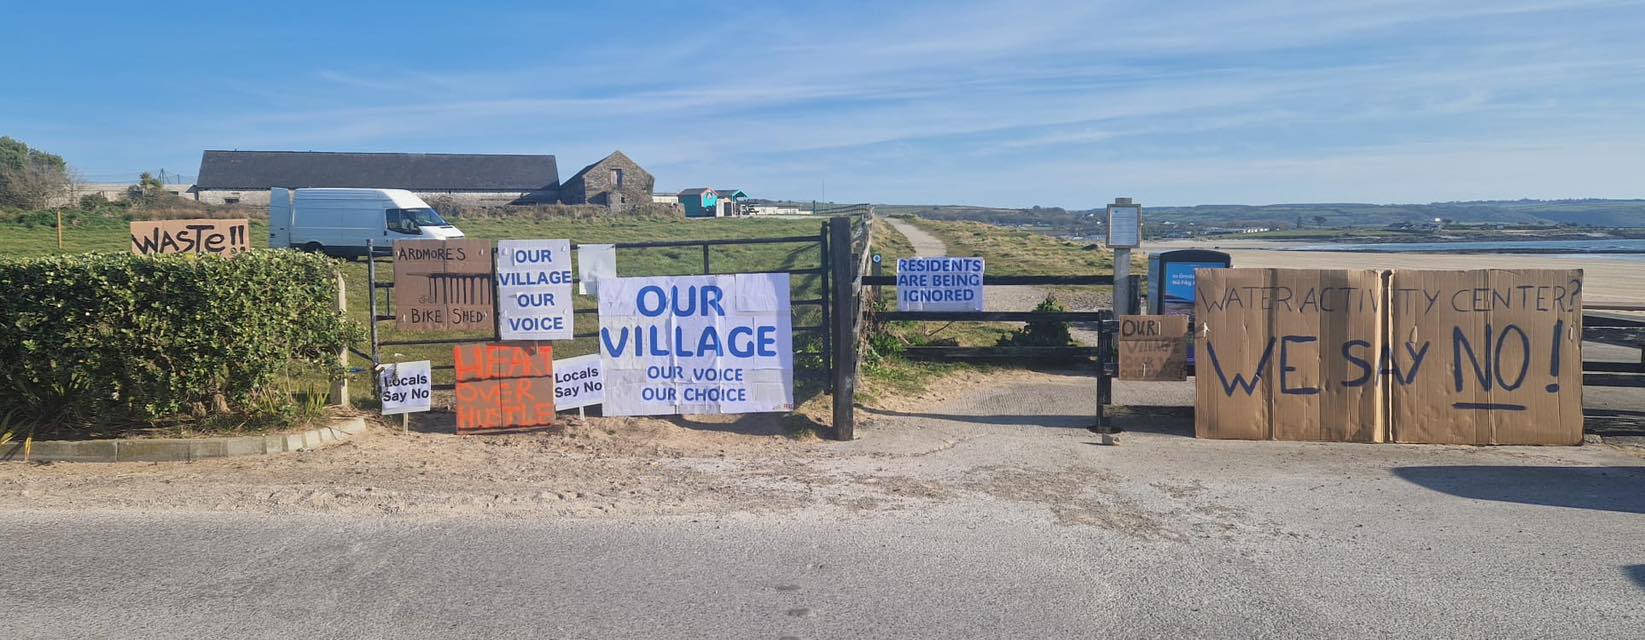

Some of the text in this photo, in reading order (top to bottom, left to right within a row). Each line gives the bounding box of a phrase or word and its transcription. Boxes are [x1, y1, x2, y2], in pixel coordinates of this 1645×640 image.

[398, 247, 466, 261] ARDMORES
[515, 249, 552, 263] OUR
[898, 259, 981, 272] RESIDENTS
[499, 271, 572, 286] VILLAGE
[898, 274, 980, 287] ARE BEING
[517, 293, 555, 308] OUR
[636, 285, 726, 317] OUR
[903, 289, 974, 302] IGNORED
[1199, 286, 1293, 313] WATER
[1451, 280, 1582, 314] CENTER?
[411, 308, 483, 325] BIKE SHED
[508, 317, 564, 331] VOICE
[601, 324, 777, 358] VILLAGE
[647, 365, 743, 382] OUR VOICE
[1206, 336, 1320, 397] WE
[1341, 340, 1430, 388] SAY
[384, 373, 428, 388] Locals
[555, 366, 599, 384] Locals
[383, 388, 430, 403] Say No
[456, 379, 535, 406] OVER
[554, 380, 603, 399] Say No
[641, 387, 746, 402] OUR CHOICE
[458, 403, 553, 428] HUSTLE
